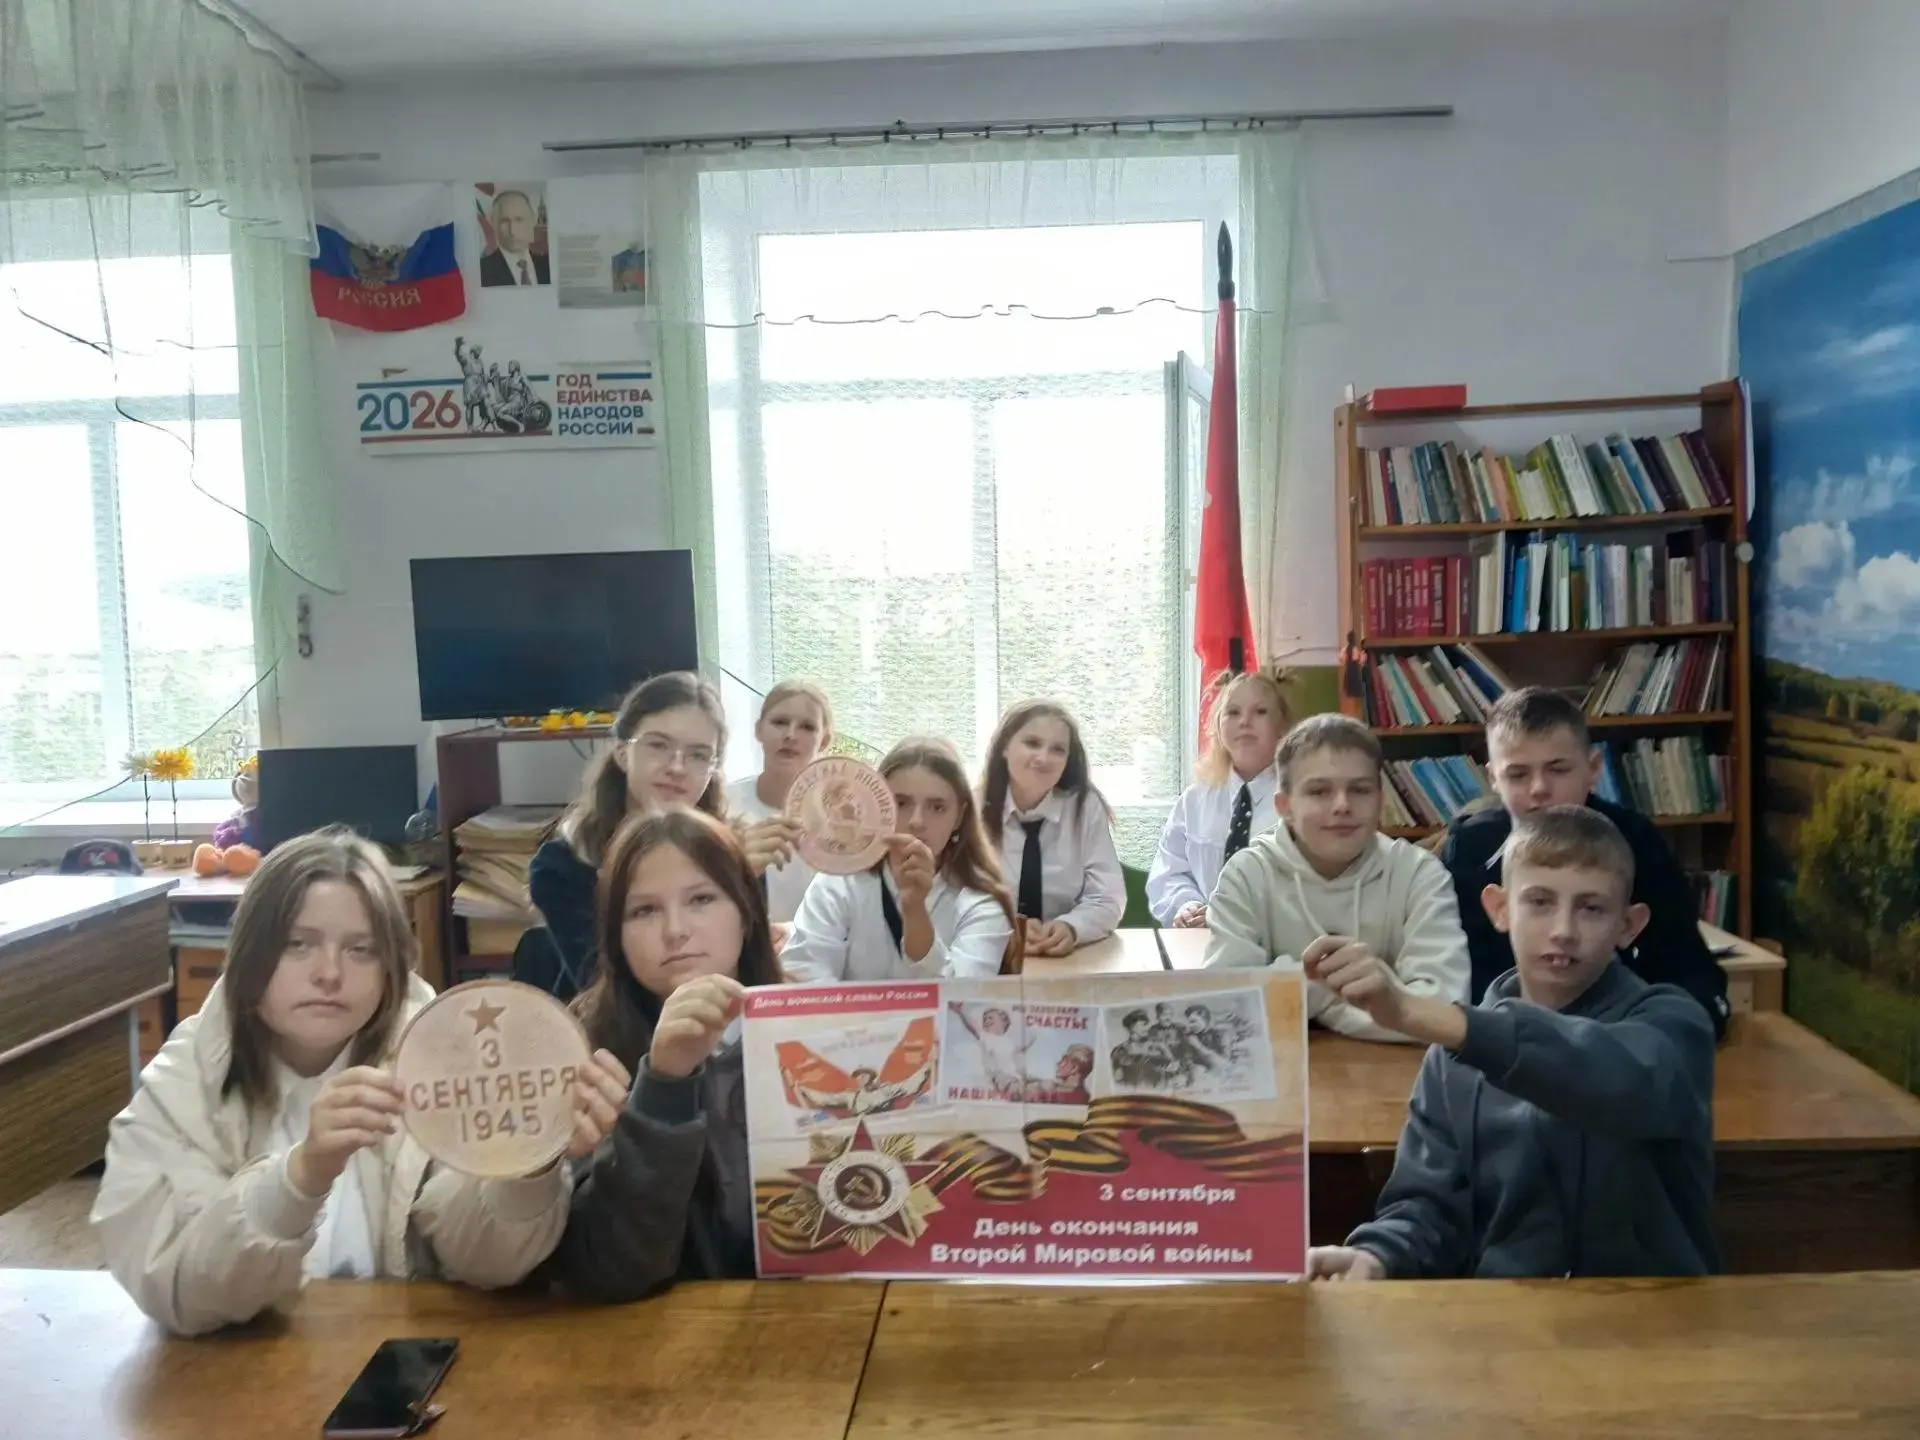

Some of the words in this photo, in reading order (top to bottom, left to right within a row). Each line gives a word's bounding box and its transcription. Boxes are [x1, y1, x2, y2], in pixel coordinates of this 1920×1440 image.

[556, 374, 592, 388] ГОД
[557, 388, 653, 405] ЕДИНСТВА
[357, 390, 462, 431] 2026
[558, 405, 644, 420] НАРОДОВ
[558, 422, 633, 436] РОССИИ
[480, 1038, 502, 1069] 3
[410, 1065, 577, 1112] СЕНТЯБРЯ
[460, 1105, 543, 1142] 1945
[1099, 1184, 1114, 1201] 3
[1120, 1183, 1236, 1205] сентября
[973, 1218, 1042, 1239] День
[1050, 1219, 1199, 1236] окончания
[931, 1243, 1027, 1268] Второй
[1034, 1243, 1156, 1268] Мировой
[1163, 1242, 1254, 1264] войны
